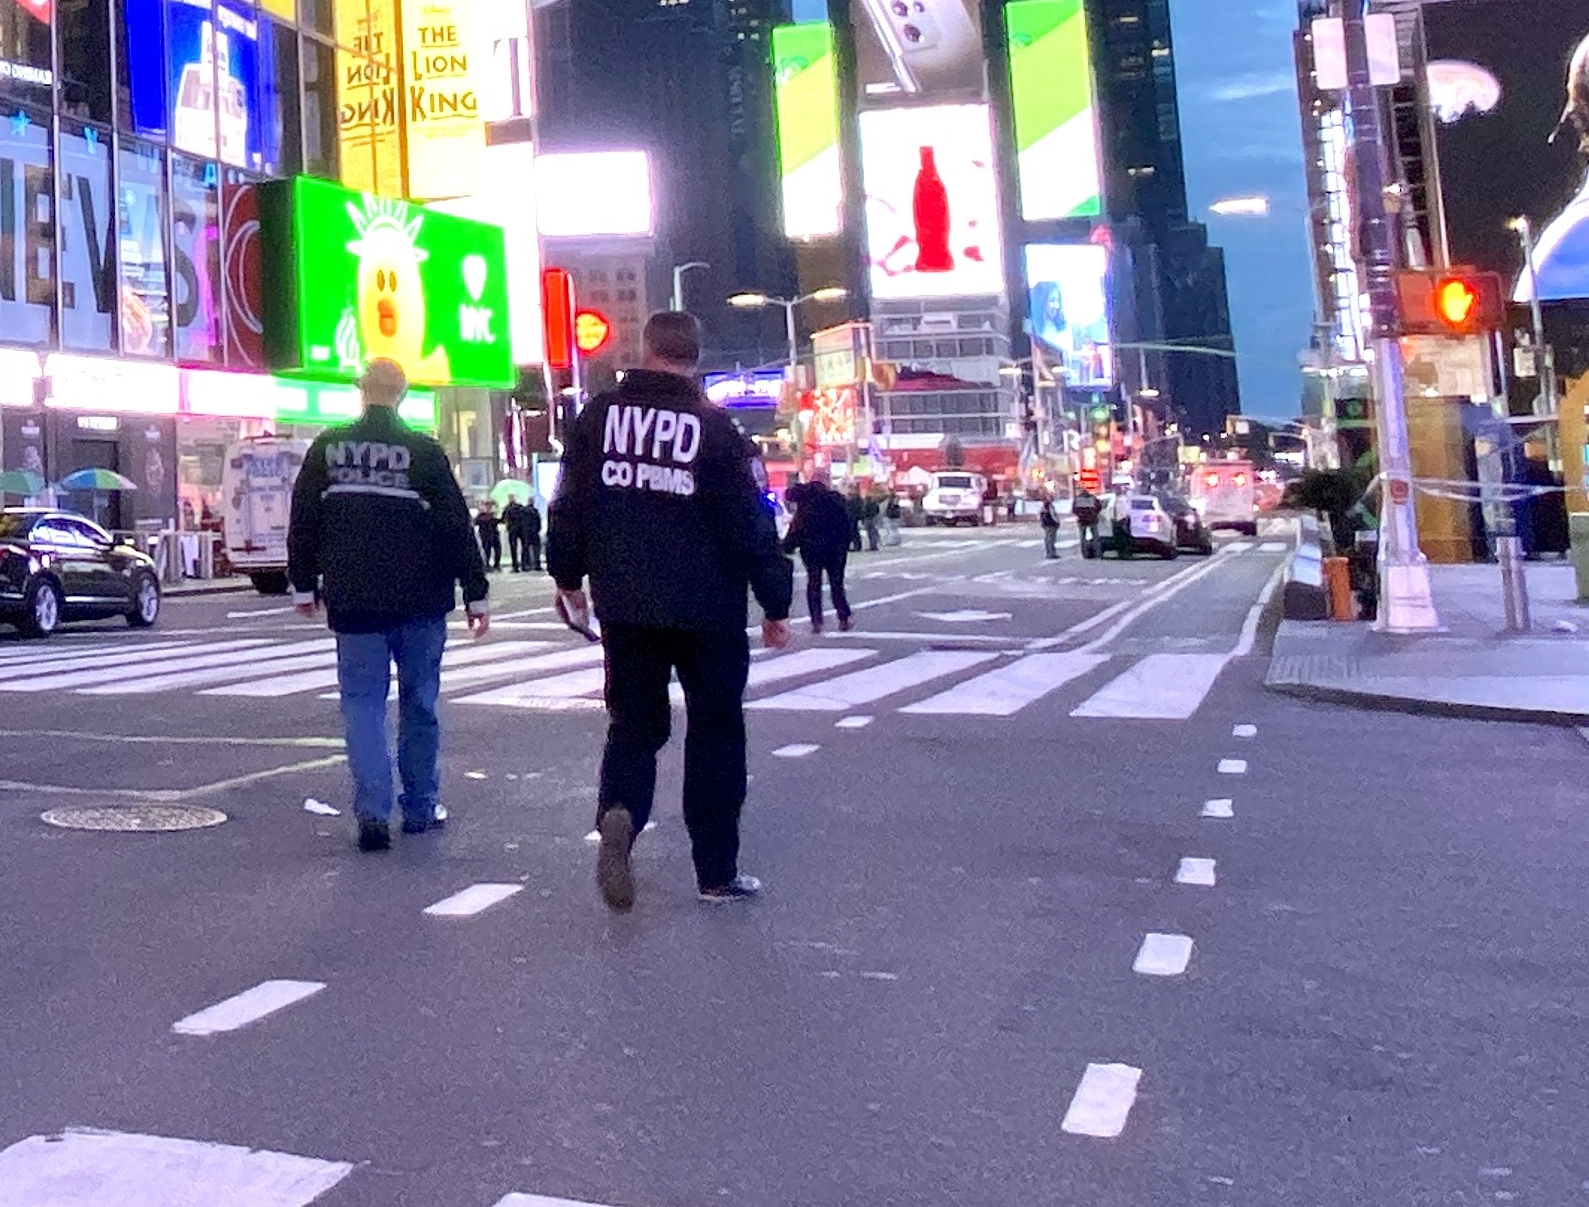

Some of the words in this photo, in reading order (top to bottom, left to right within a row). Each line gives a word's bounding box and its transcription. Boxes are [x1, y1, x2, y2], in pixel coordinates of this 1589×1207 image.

[418, 25, 457, 46] THE
[412, 51, 468, 81] LION
[410, 86, 478, 122] KING
[603, 404, 701, 463] NYPD
[325, 440, 411, 469] NYPD
[601, 460, 633, 487] CO
